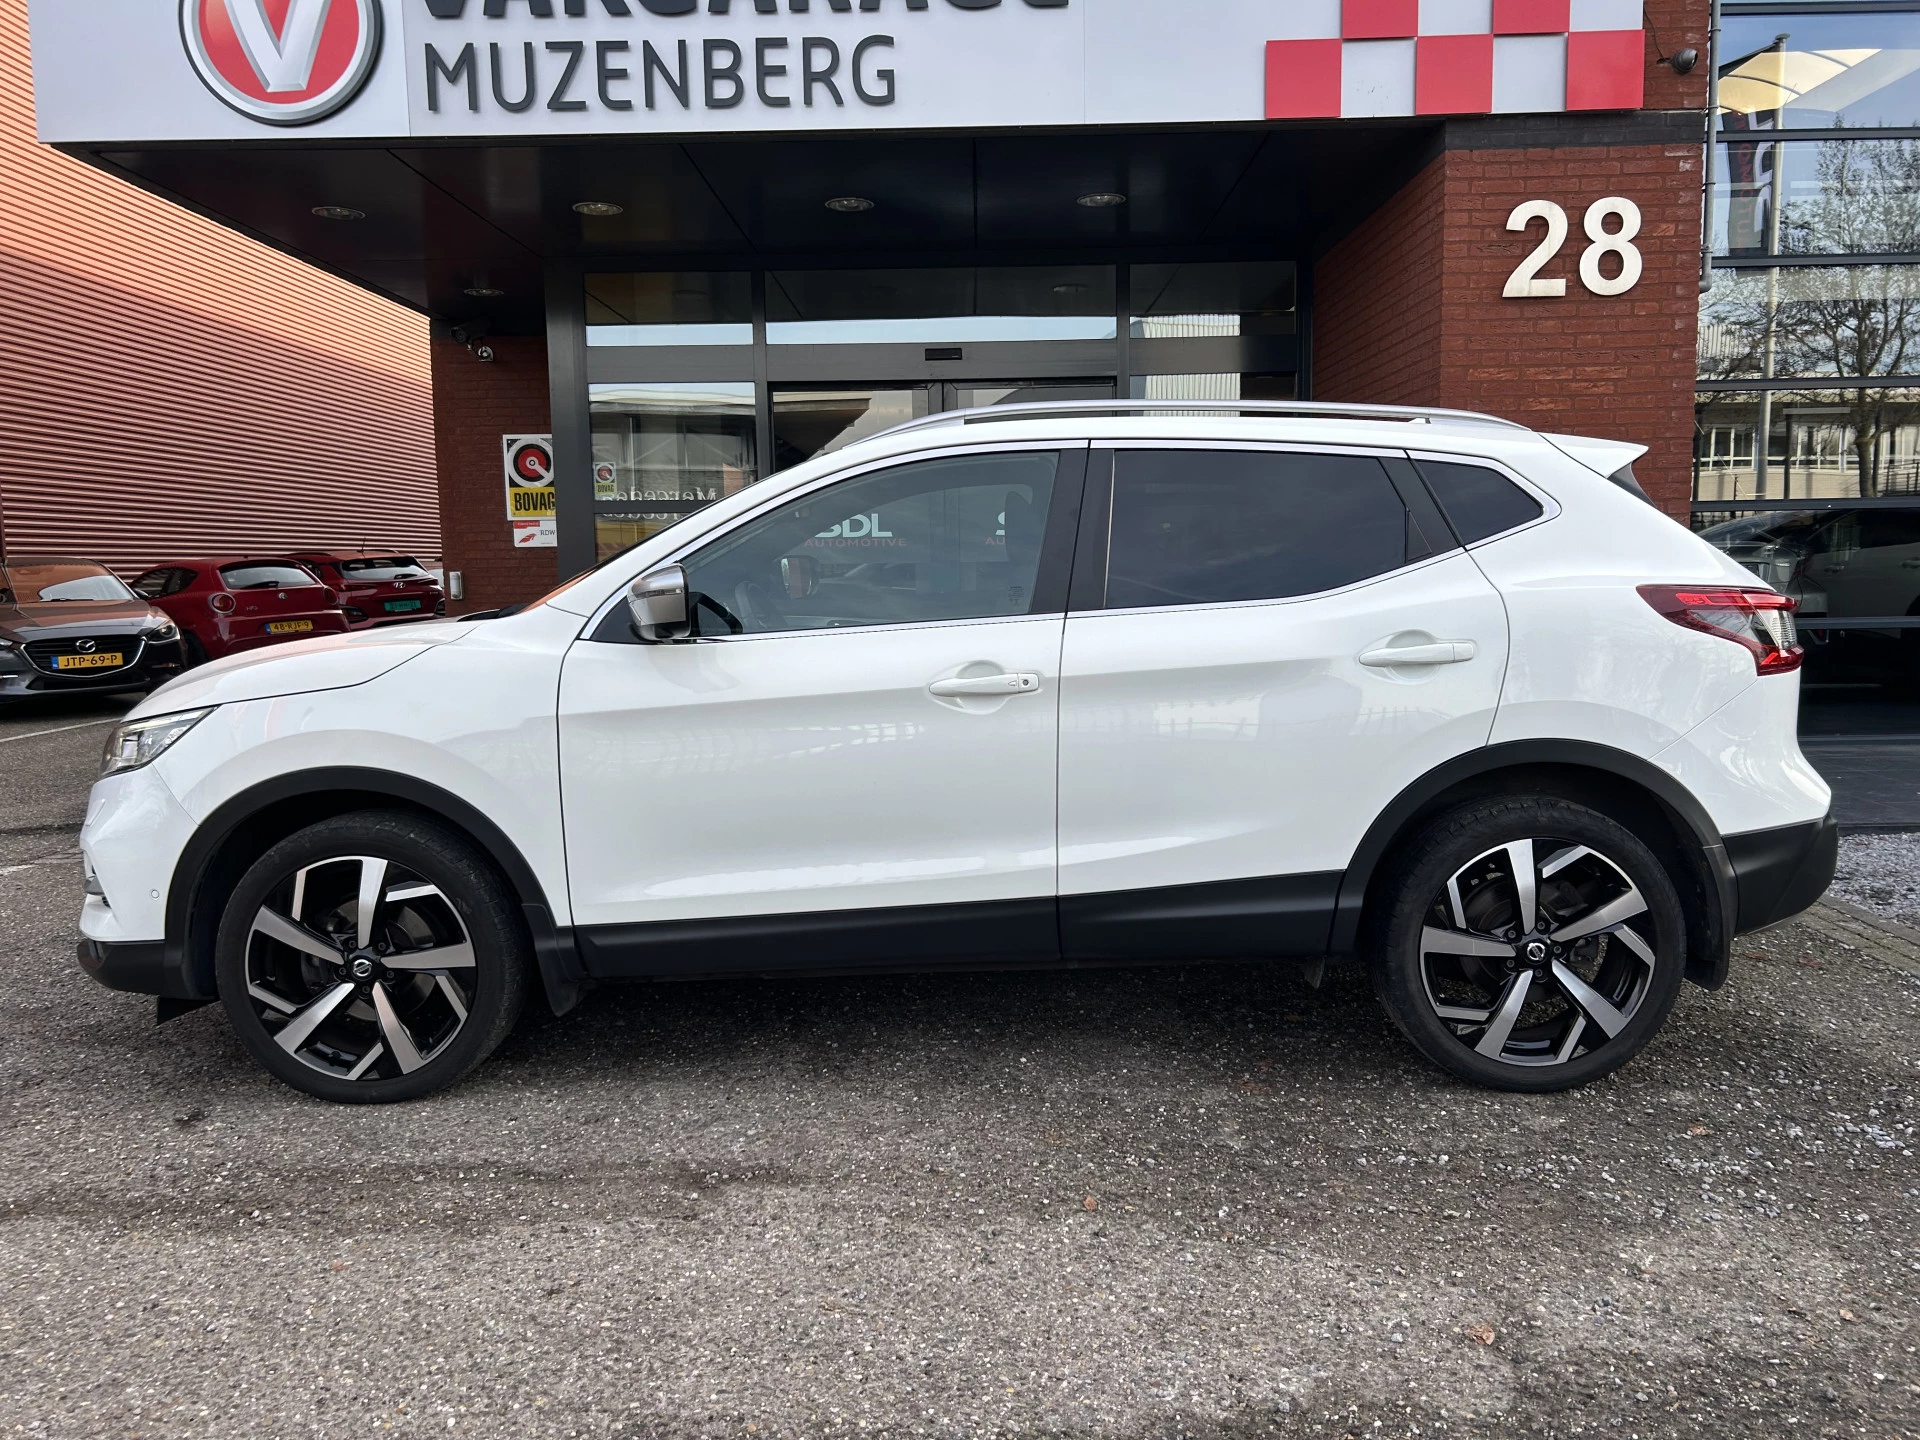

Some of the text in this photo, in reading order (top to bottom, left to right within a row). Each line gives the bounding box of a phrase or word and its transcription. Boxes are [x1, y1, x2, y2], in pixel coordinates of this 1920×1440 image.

[425, 36, 896, 113] MUZENBERG
[1502, 197, 1643, 298] 28
[597, 484, 615, 493] BOVAG
[514, 491, 556, 511] BOVAG
[804, 538, 907, 547] AUTOMOTIVE
[273, 621, 310, 631] 48-RJF-9
[63, 654, 118, 667] JTP-69-P
